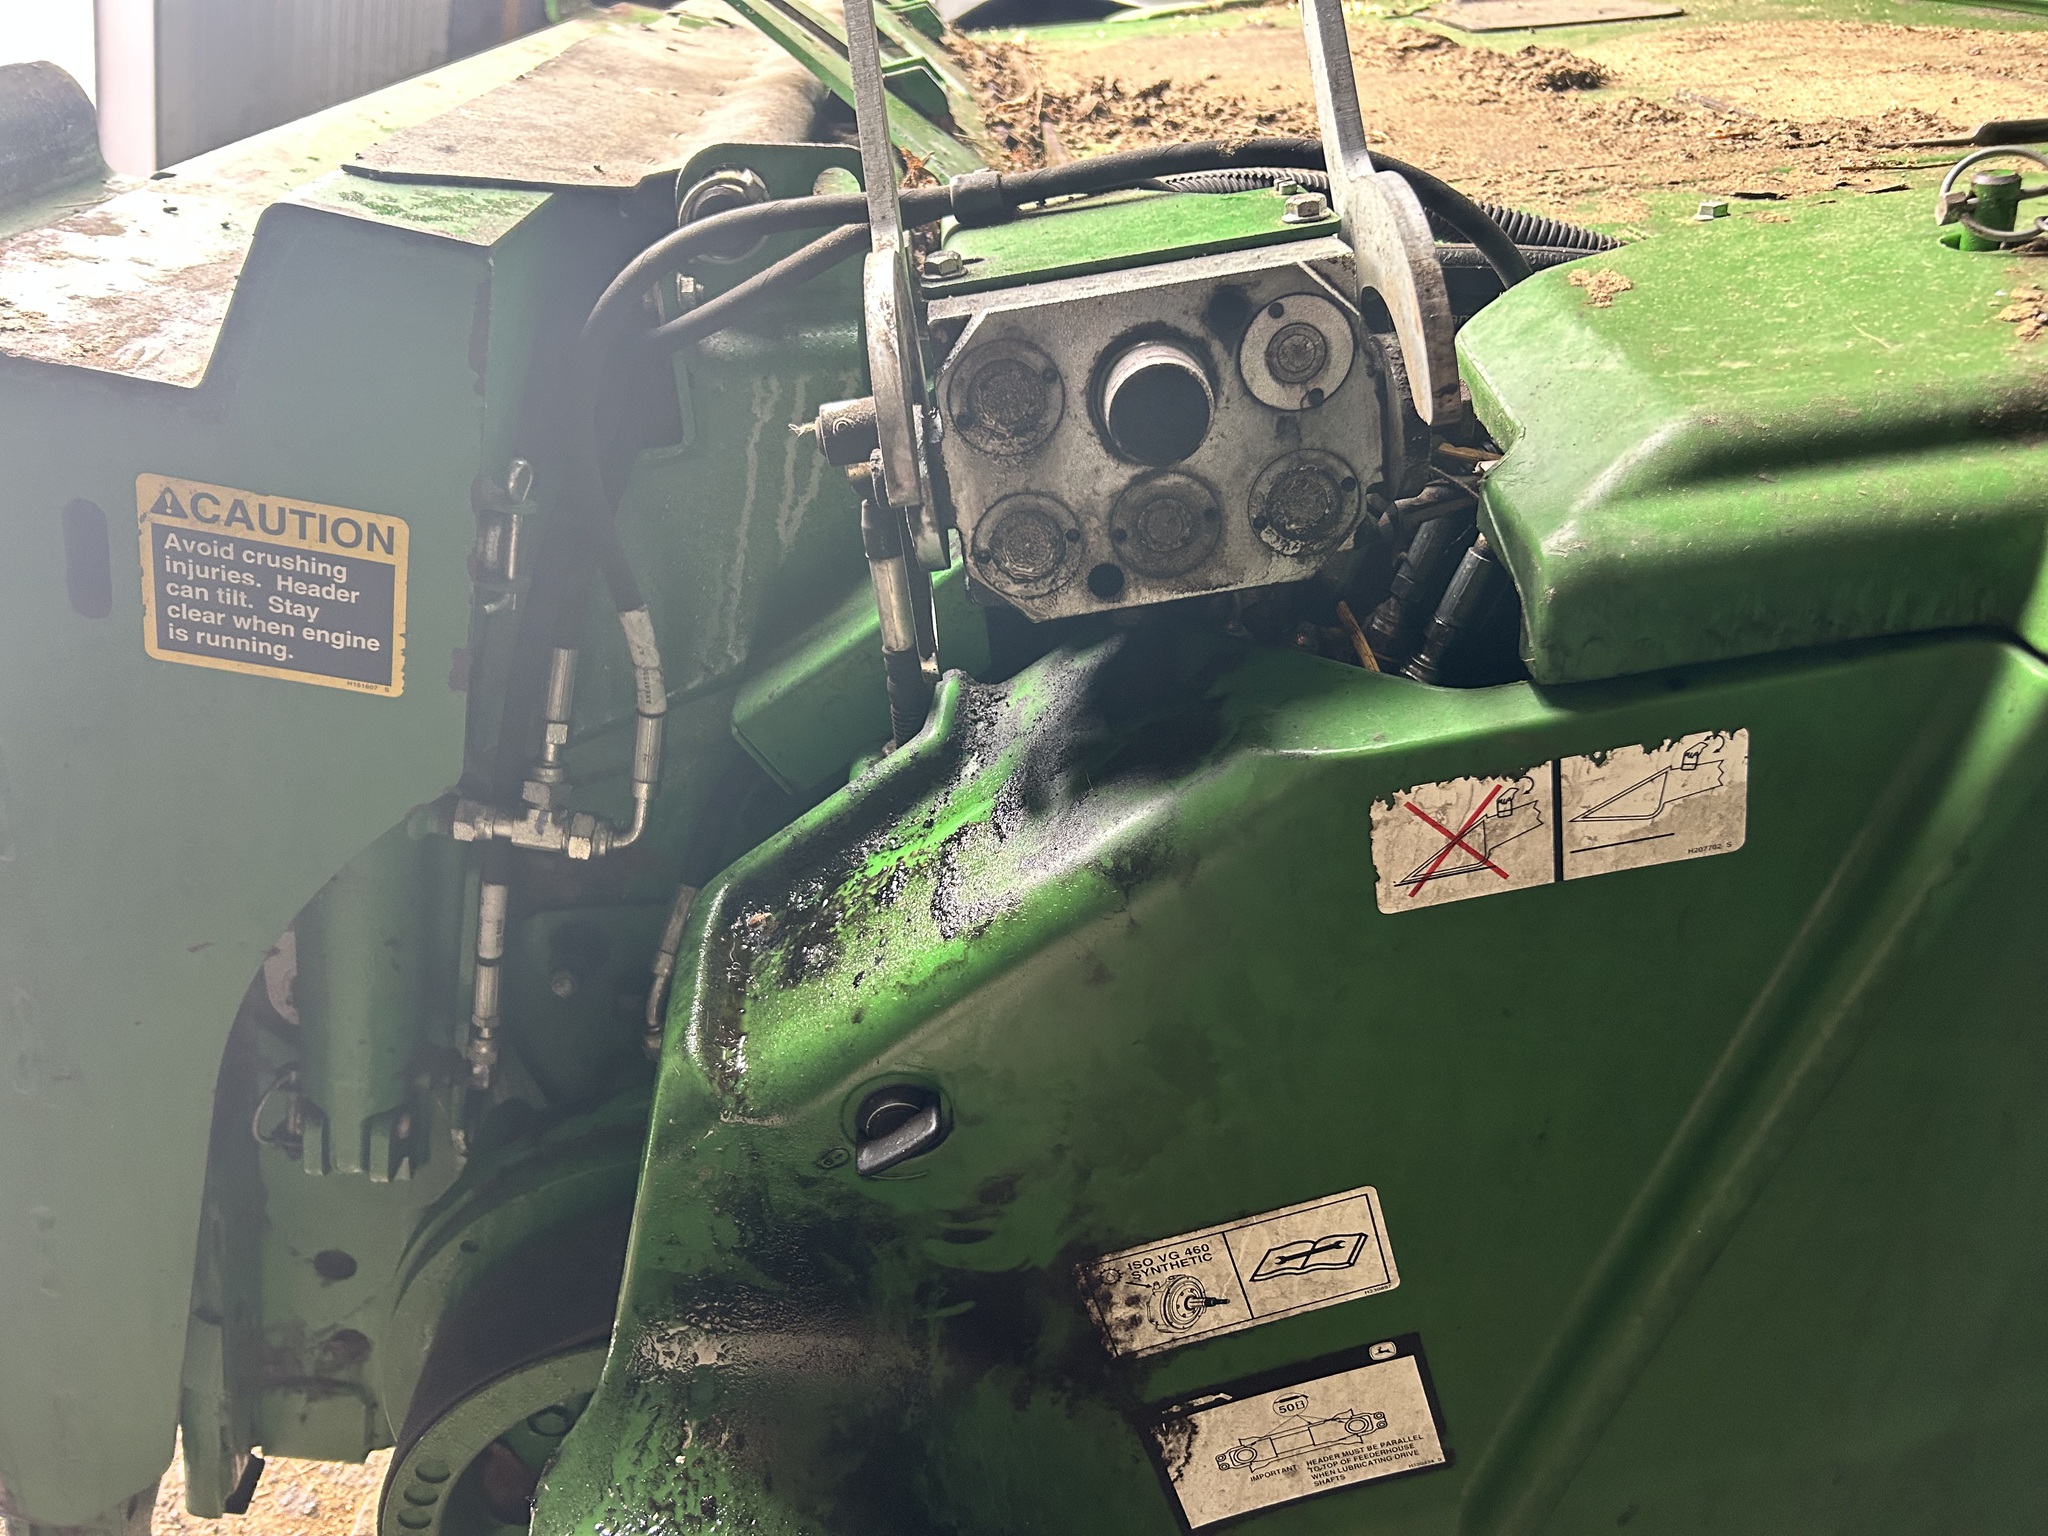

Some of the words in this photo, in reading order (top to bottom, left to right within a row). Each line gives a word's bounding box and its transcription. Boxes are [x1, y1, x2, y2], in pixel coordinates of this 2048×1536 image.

[190, 492, 395, 555] CAUTION
[164, 532, 234, 560] Avoid
[242, 549, 348, 582] crushing
[165, 555, 262, 588] injuries.
[277, 575, 360, 604] Header
[166, 582, 209, 601] can
[216, 587, 254, 608] tilt.
[268, 595, 320, 623] Stay
[167, 604, 226, 626] clear
[232, 614, 295, 637] when
[302, 626, 381, 652] engine
[168, 623, 189, 642] is
[196, 630, 294, 661] running.
[1127, 1257, 1153, 1271] ISO
[1158, 1251, 1181, 1263] VG
[1185, 1243, 1210, 1256] 460
[1131, 1253, 1213, 1279] SYNTHETIC
[1306, 1453, 1341, 1466] HEADER
[1341, 1446, 1365, 1457] MUST
[1366, 1442, 1378, 1452] BE
[1379, 1433, 1424, 1448] PARALLEL
[1309, 1465, 1321, 1473] TO
[1322, 1461, 1338, 1471] TOP
[1340, 1456, 1352, 1465] OF
[1353, 1442, 1415, 1462] FEEDERHOUSE
[1311, 1469, 1336, 1480] WHEN
[1337, 1455, 1393, 1473] LUBRICATING
[1394, 1449, 1420, 1460] DRIVE
[1313, 1474, 1346, 1487] SHAFTS
